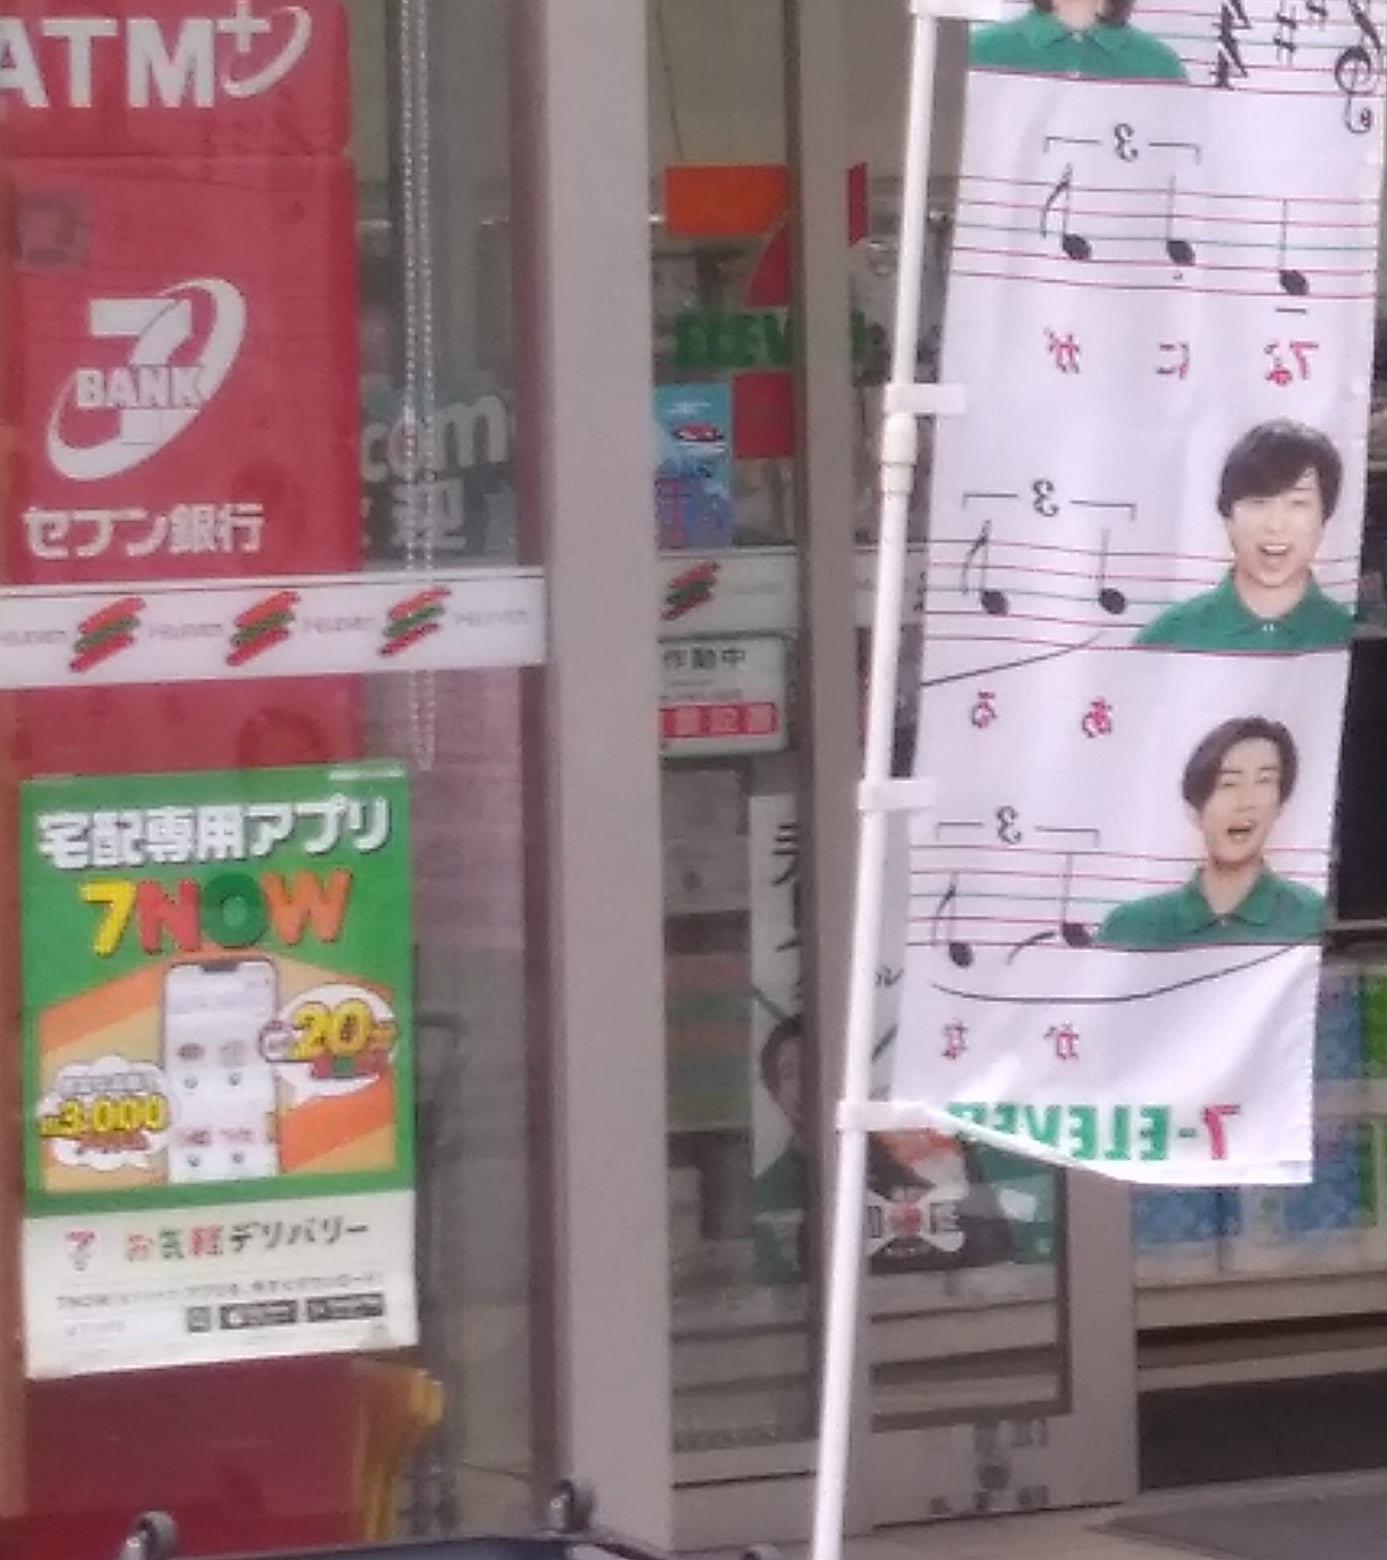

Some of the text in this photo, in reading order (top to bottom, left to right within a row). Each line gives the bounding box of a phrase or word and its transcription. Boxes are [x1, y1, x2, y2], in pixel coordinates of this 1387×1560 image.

[76, 367, 205, 410] BANK
[23, 502, 266, 559] セブン銀行
[36, 793, 391, 871] 宅配専用アプリ
[80, 869, 354, 957] 7NOW
